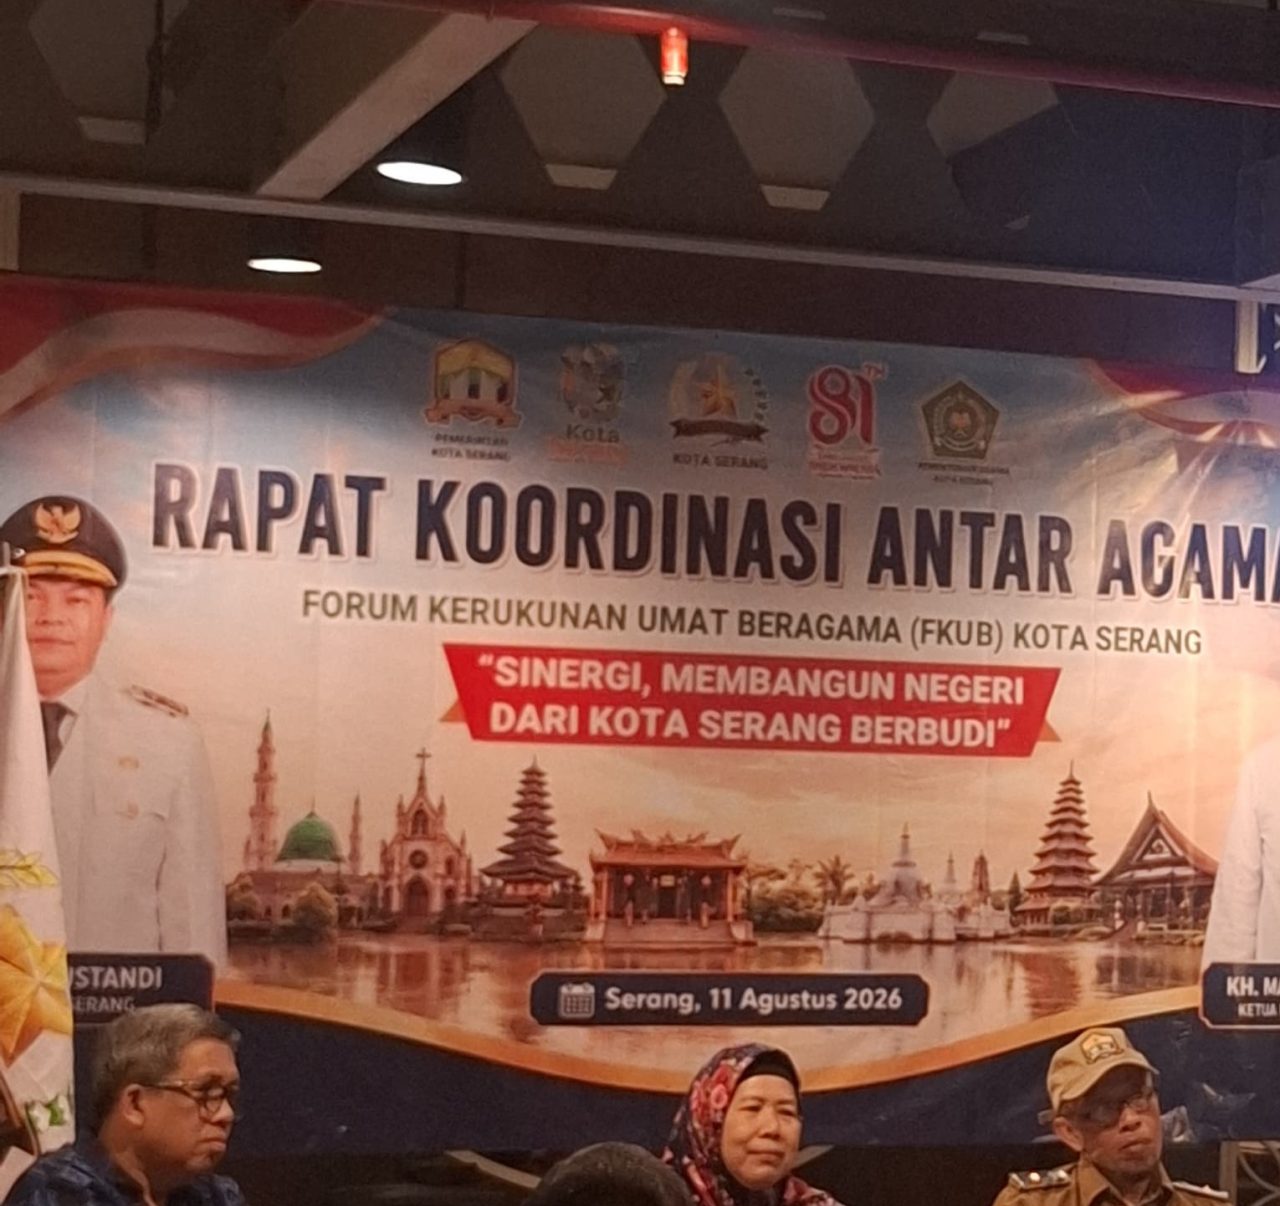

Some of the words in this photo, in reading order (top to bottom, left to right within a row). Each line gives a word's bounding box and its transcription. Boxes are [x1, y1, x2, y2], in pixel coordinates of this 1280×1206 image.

[809, 366, 873, 445] 81
[566, 424, 620, 443] Kota
[673, 453, 710, 466] KOTA
[714, 454, 768, 470] SERANG
[152, 463, 386, 557] RAPAT
[415, 478, 842, 583] KOORDINASI
[867, 506, 1073, 593] ANTAR
[302, 589, 418, 622] FORUM
[429, 595, 627, 632] KERUKUNAN
[638, 604, 729, 636] UMAT
[738, 609, 900, 644] BERAGAMA
[910, 616, 1003, 653] (FKUB)
[1014, 622, 1089, 651] KOTA
[1096, 625, 1202, 655] SERANG
[478, 652, 652, 698] “SINERGI,
[661, 663, 894, 701] MEMBANGUN
[904, 673, 1024, 706] NEGERI
[489, 700, 579, 736] DARI
[589, 704, 690, 739] KOTA
[699, 708, 842, 744] SERANG
[604, 986, 701, 1015] Serang,
[709, 988, 731, 1009] 11
[739, 987, 837, 1015] Agustus
[844, 987, 902, 1010] 2026
[1227, 976, 1258, 997] KH.
[1238, 1002, 1277, 1017] KETUA
